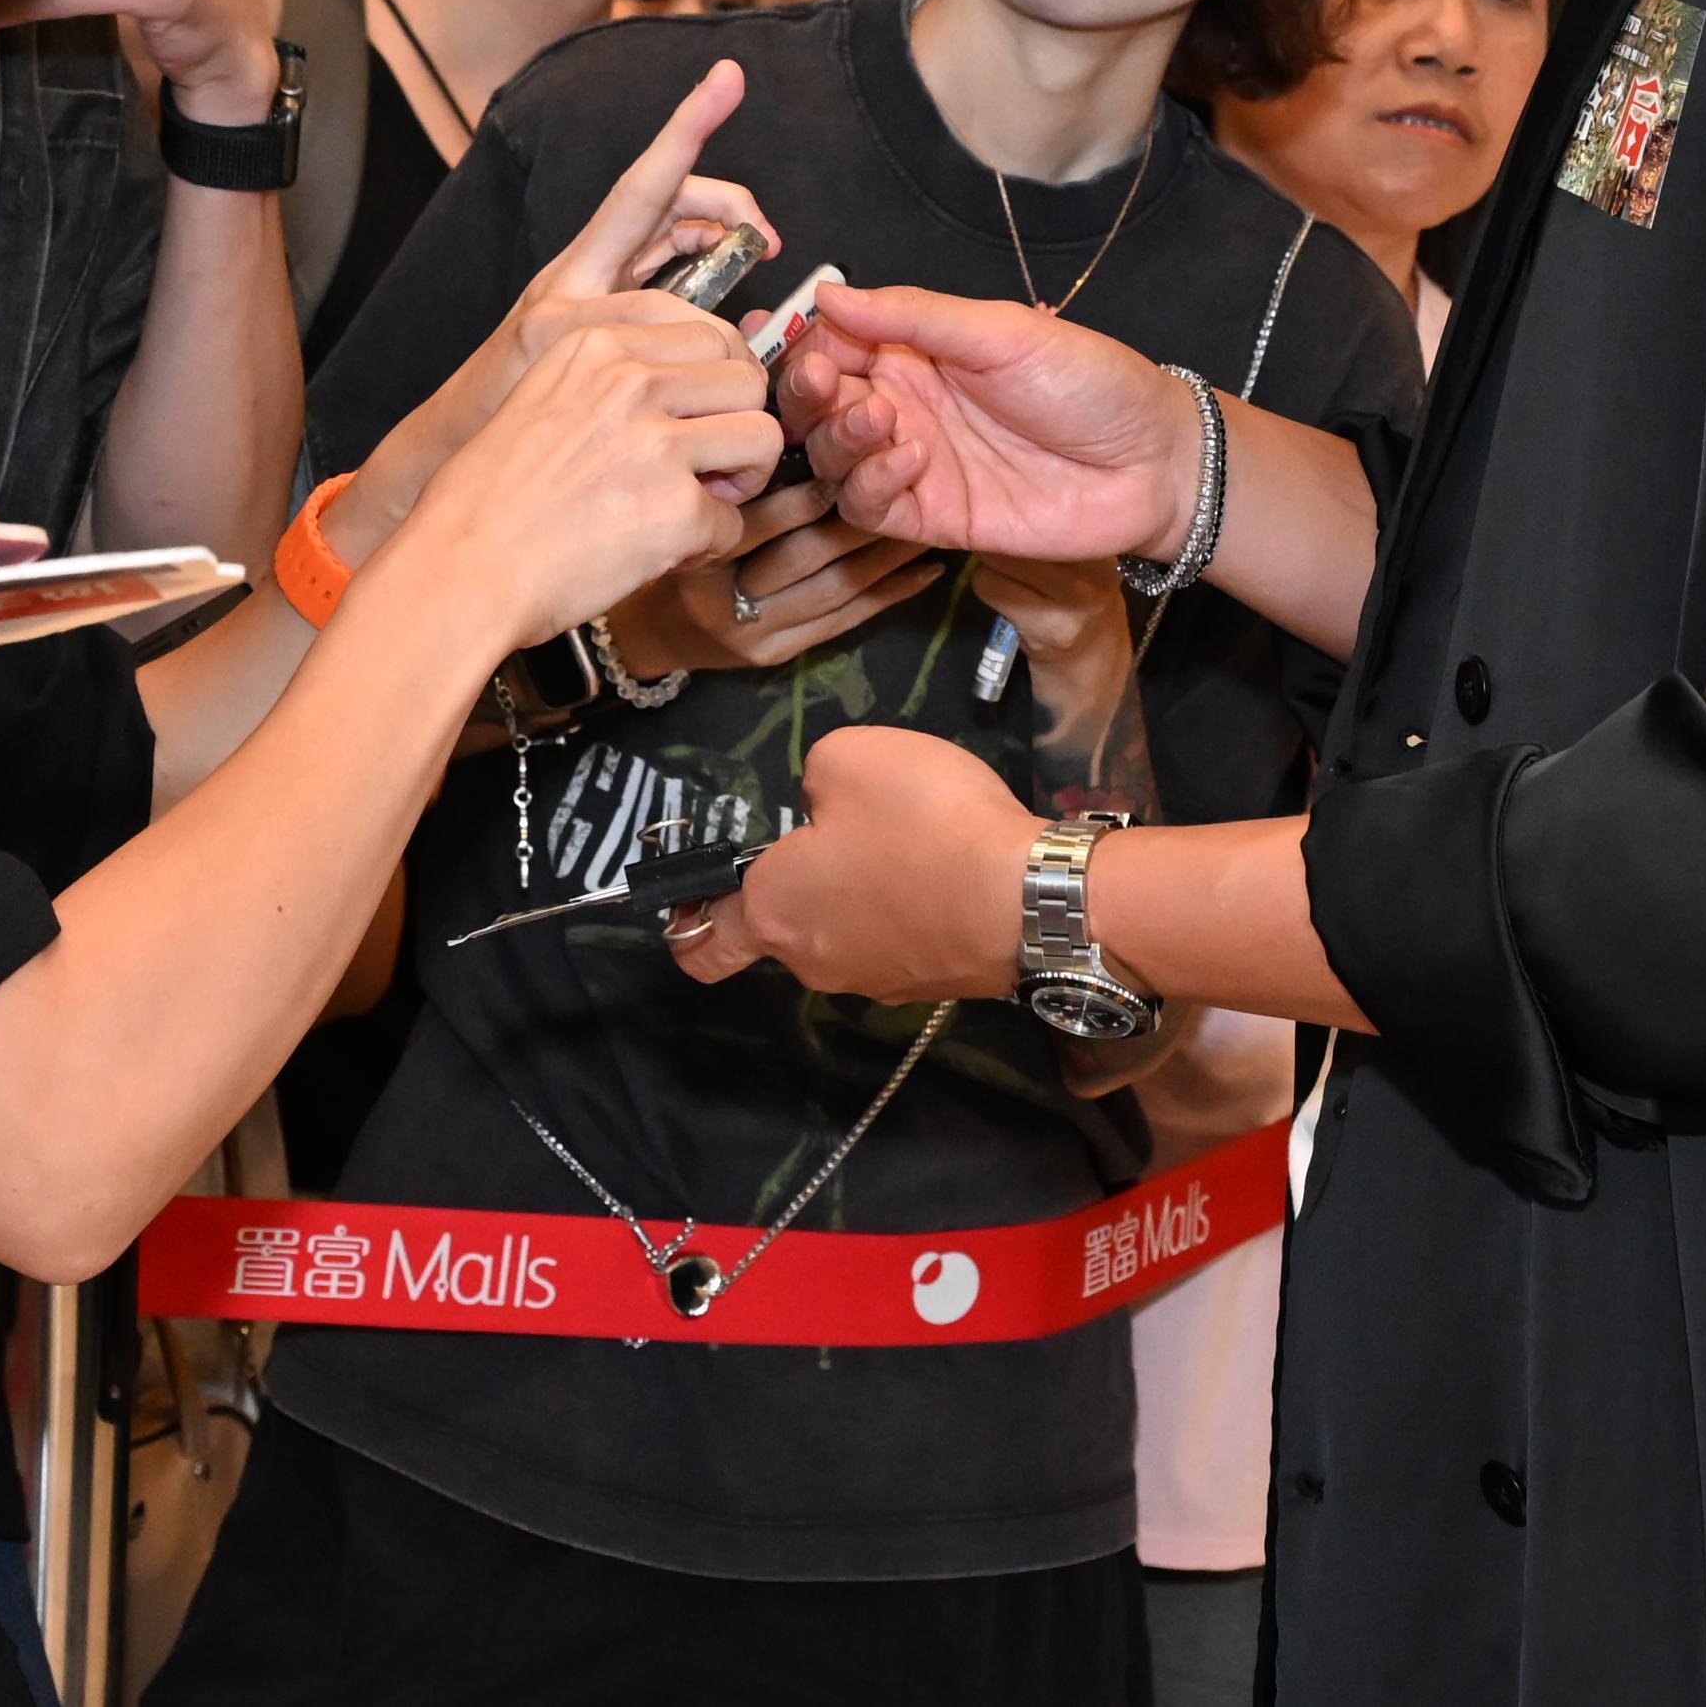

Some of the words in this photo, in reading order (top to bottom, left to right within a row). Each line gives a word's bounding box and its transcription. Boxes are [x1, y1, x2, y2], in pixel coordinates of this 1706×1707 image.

[759, 341, 782, 368] EBRA
[227, 1224, 371, 1301] 置富
[381, 1229, 558, 1320] Malls
[1082, 1209, 1141, 1299] 置富
[1141, 1180, 1211, 1269] Malls
